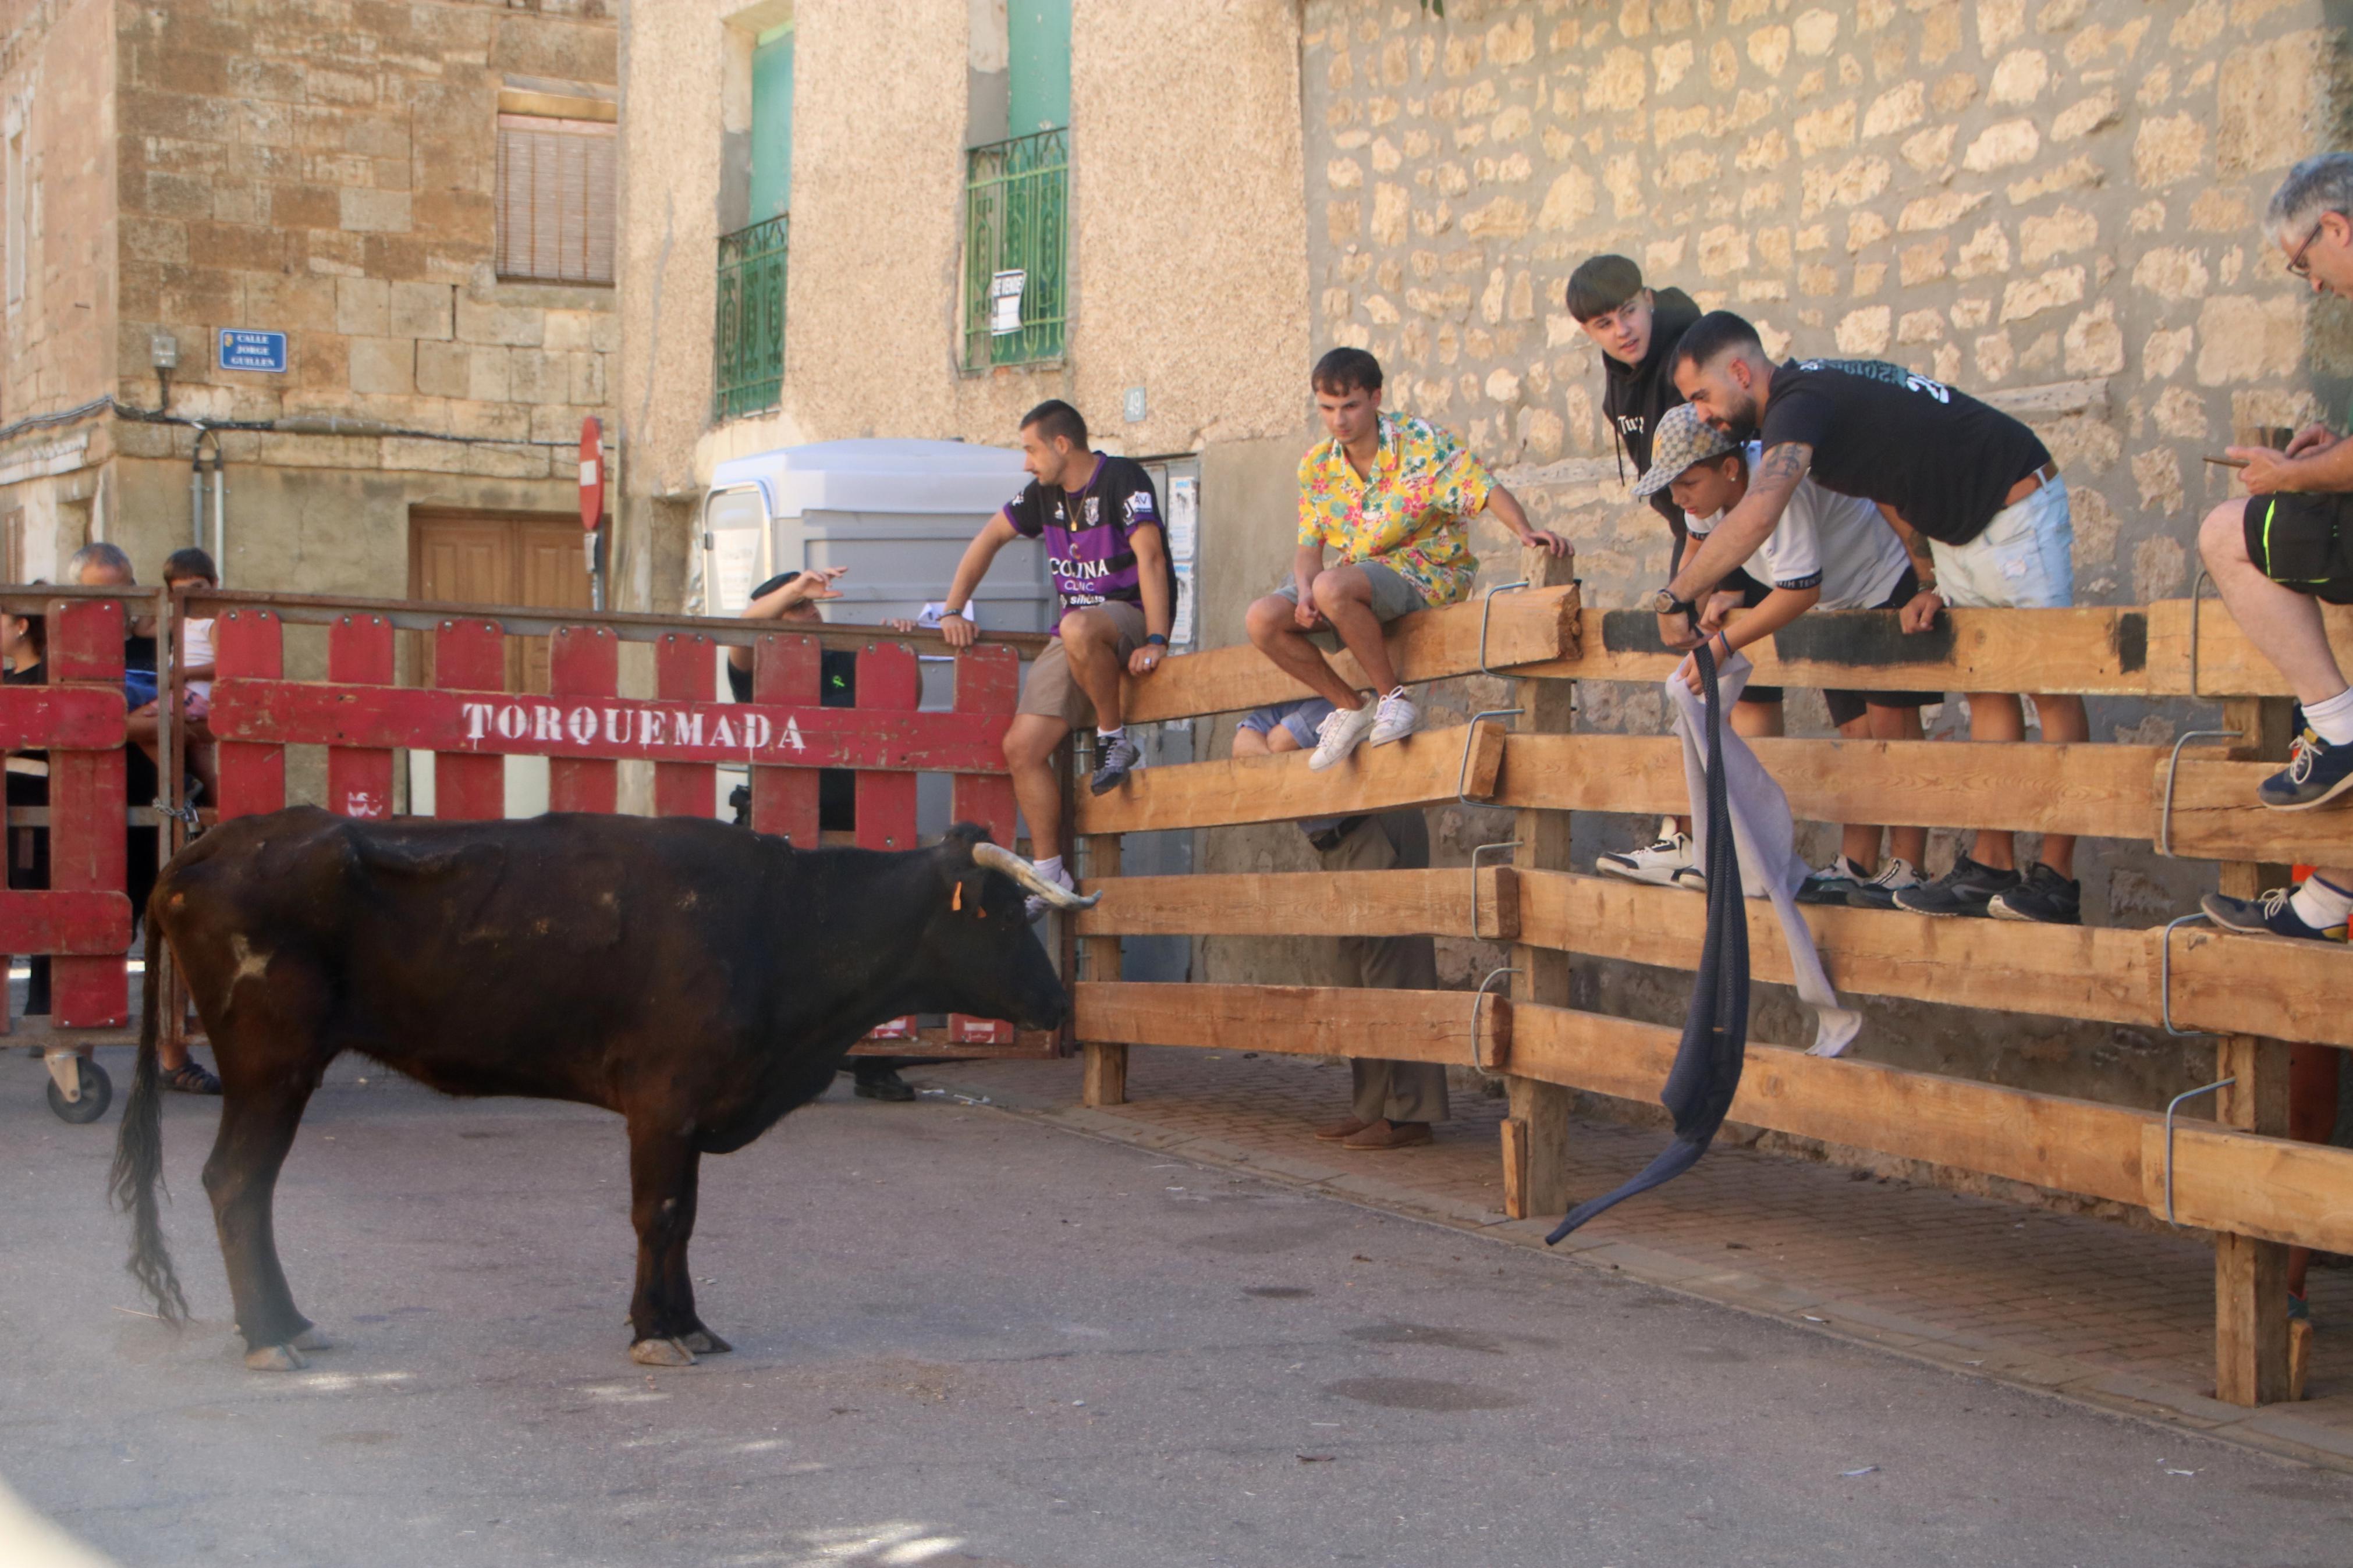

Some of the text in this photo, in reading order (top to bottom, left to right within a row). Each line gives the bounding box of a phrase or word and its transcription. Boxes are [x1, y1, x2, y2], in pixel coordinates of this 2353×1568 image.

[236, 334, 269, 344] CALLE
[236, 345, 270, 355] JORGE
[1128, 391, 1141, 415] 49
[1134, 495, 1147, 505] AV
[1049, 557, 1110, 579] COINA
[463, 703, 807, 749] TORQUEMADA
